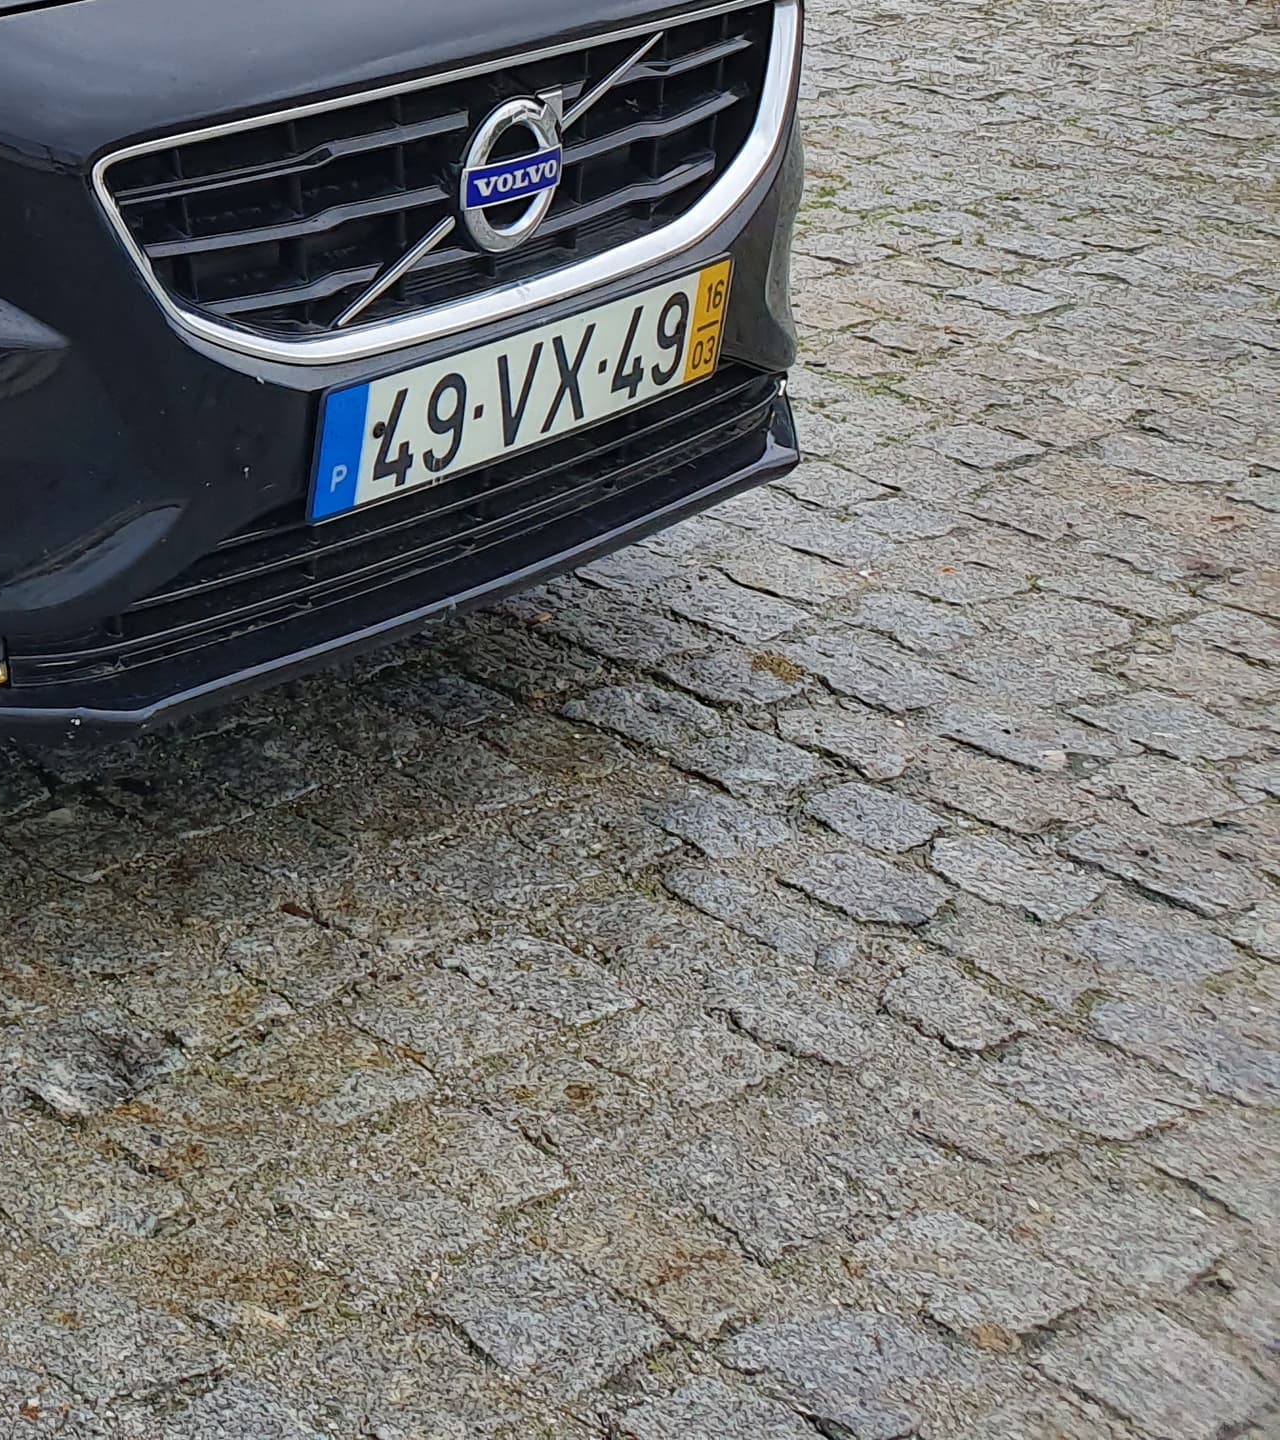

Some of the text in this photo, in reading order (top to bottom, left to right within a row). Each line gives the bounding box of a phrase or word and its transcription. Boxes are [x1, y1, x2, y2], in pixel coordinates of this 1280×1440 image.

[473, 159, 558, 198] VOLVO
[705, 279, 725, 313] 16
[691, 335, 716, 370] 03
[330, 464, 348, 493] P
